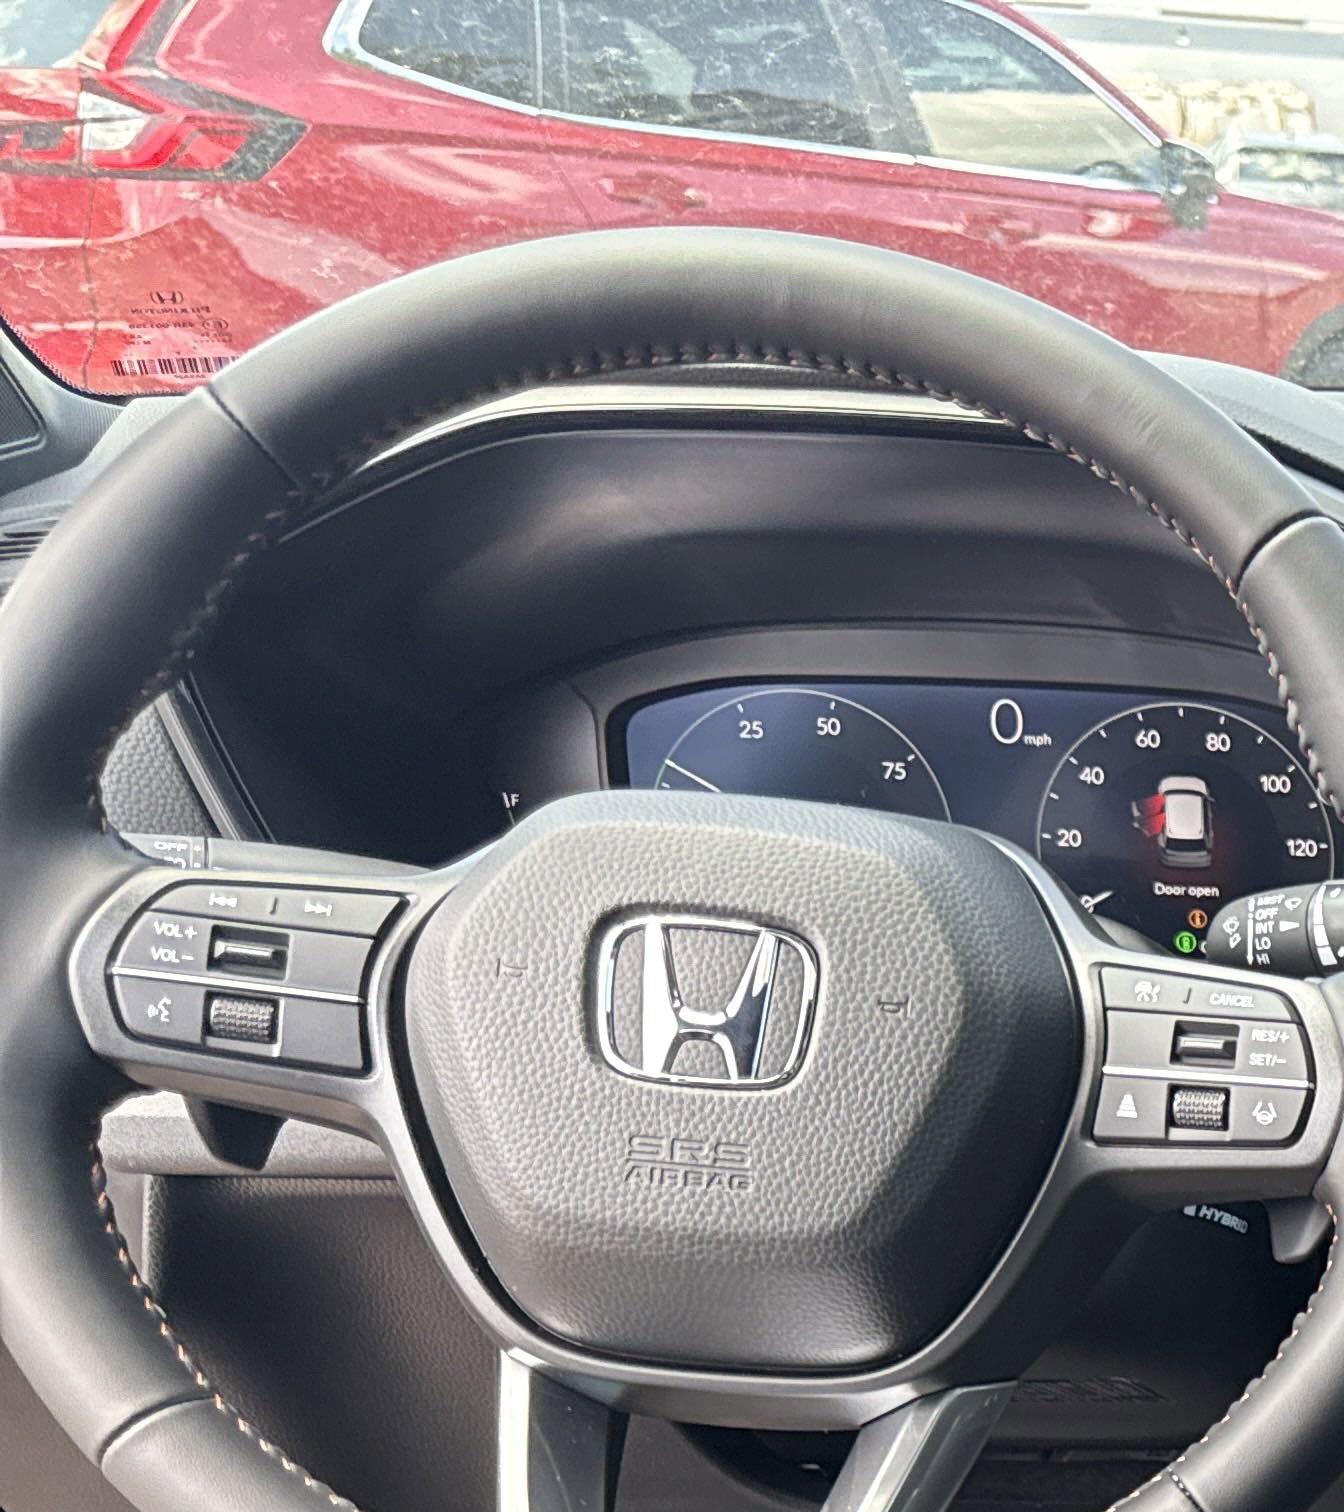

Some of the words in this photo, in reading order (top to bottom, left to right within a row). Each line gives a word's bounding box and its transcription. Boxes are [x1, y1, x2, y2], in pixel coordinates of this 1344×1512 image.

[738, 720, 764, 739] 25
[816, 718, 841, 736] 50
[990, 698, 1024, 745] 0
[1023, 733, 1052, 747] mph
[1135, 730, 1161, 748] 60
[1206, 733, 1231, 752] 80
[882, 761, 907, 781] 75
[1079, 767, 1105, 786] 40
[1260, 775, 1292, 793] 100
[153, 840, 188, 852] OFF
[1057, 829, 1082, 848] 20
[1286, 839, 1318, 858] 120
[1154, 882, 1186, 896] Door
[1188, 886, 1220, 898] open
[1257, 894, 1286, 906] MIST
[1255, 908, 1278, 920] OFF
[1255, 921, 1274, 934] INT
[1255, 937, 1271, 950] LO
[1256, 953, 1270, 965] HI
[1209, 993, 1255, 1008] CANCEL
[1251, 1029, 1290, 1043] RES/+
[628, 1135, 750, 1166] SRS
[625, 1165, 752, 1190] AIRBAG
[1199, 1204, 1249, 1234] HYBRID
